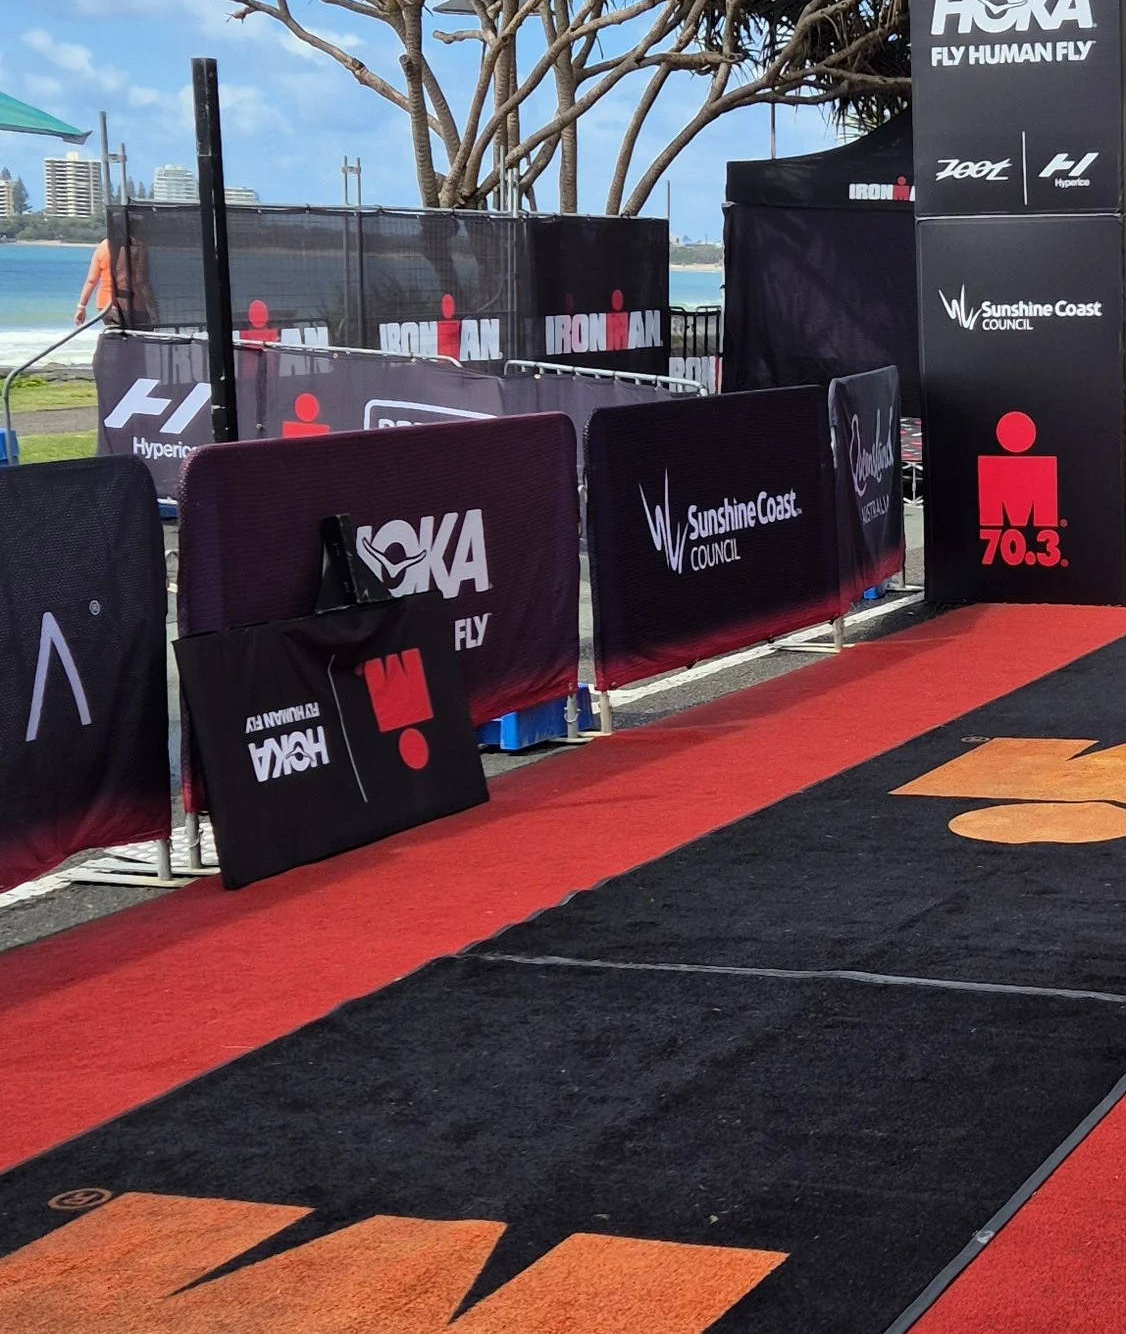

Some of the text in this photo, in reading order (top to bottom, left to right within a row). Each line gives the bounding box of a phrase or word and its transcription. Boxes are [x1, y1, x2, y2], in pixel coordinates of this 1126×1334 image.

[931, 40, 1094, 67] FLY HUMAN FLY
[981, 300, 1103, 318] Sunshine Coast
[982, 318, 1034, 331] COUNCIL
[379, 319, 500, 363] IRONMAN
[545, 310, 661, 356] IRONMAN
[687, 488, 798, 542] Sunshine Coast
[690, 538, 742, 572] COUNCIL
[980, 529, 1061, 567] 70.3
[454, 615, 489, 652] FLY
[248, 725, 330, 783] HOKA
